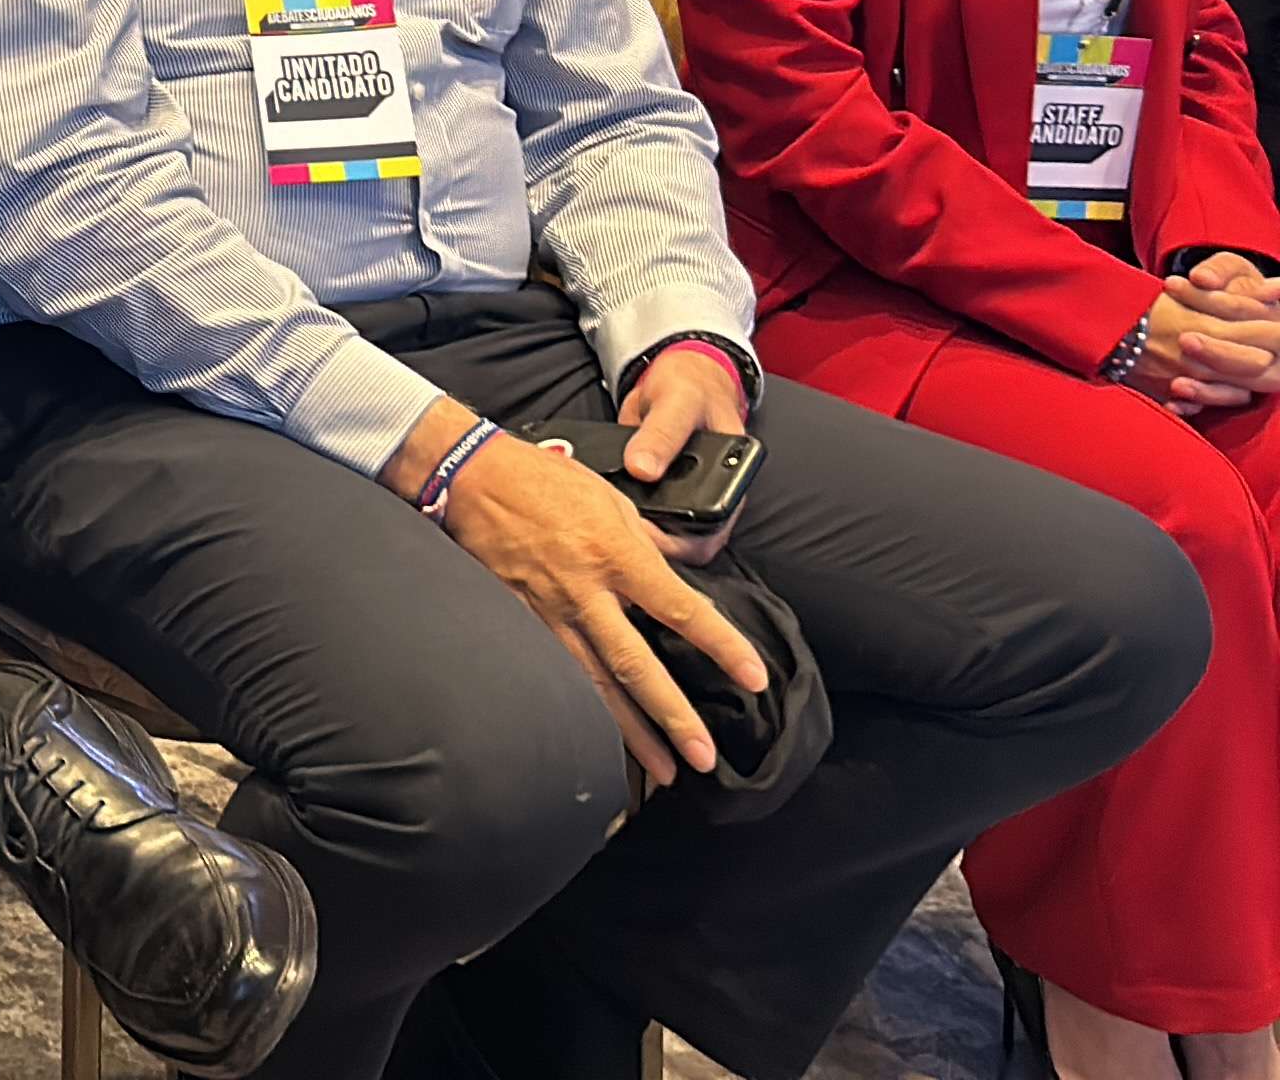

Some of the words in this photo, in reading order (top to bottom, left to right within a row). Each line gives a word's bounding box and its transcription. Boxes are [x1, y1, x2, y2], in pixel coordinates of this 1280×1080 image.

[283, 52, 378, 80] INVITADO
[277, 73, 392, 103] CANDIDATO
[1043, 104, 1101, 126] STAFF
[1030, 124, 1122, 146] ANDIDATO
